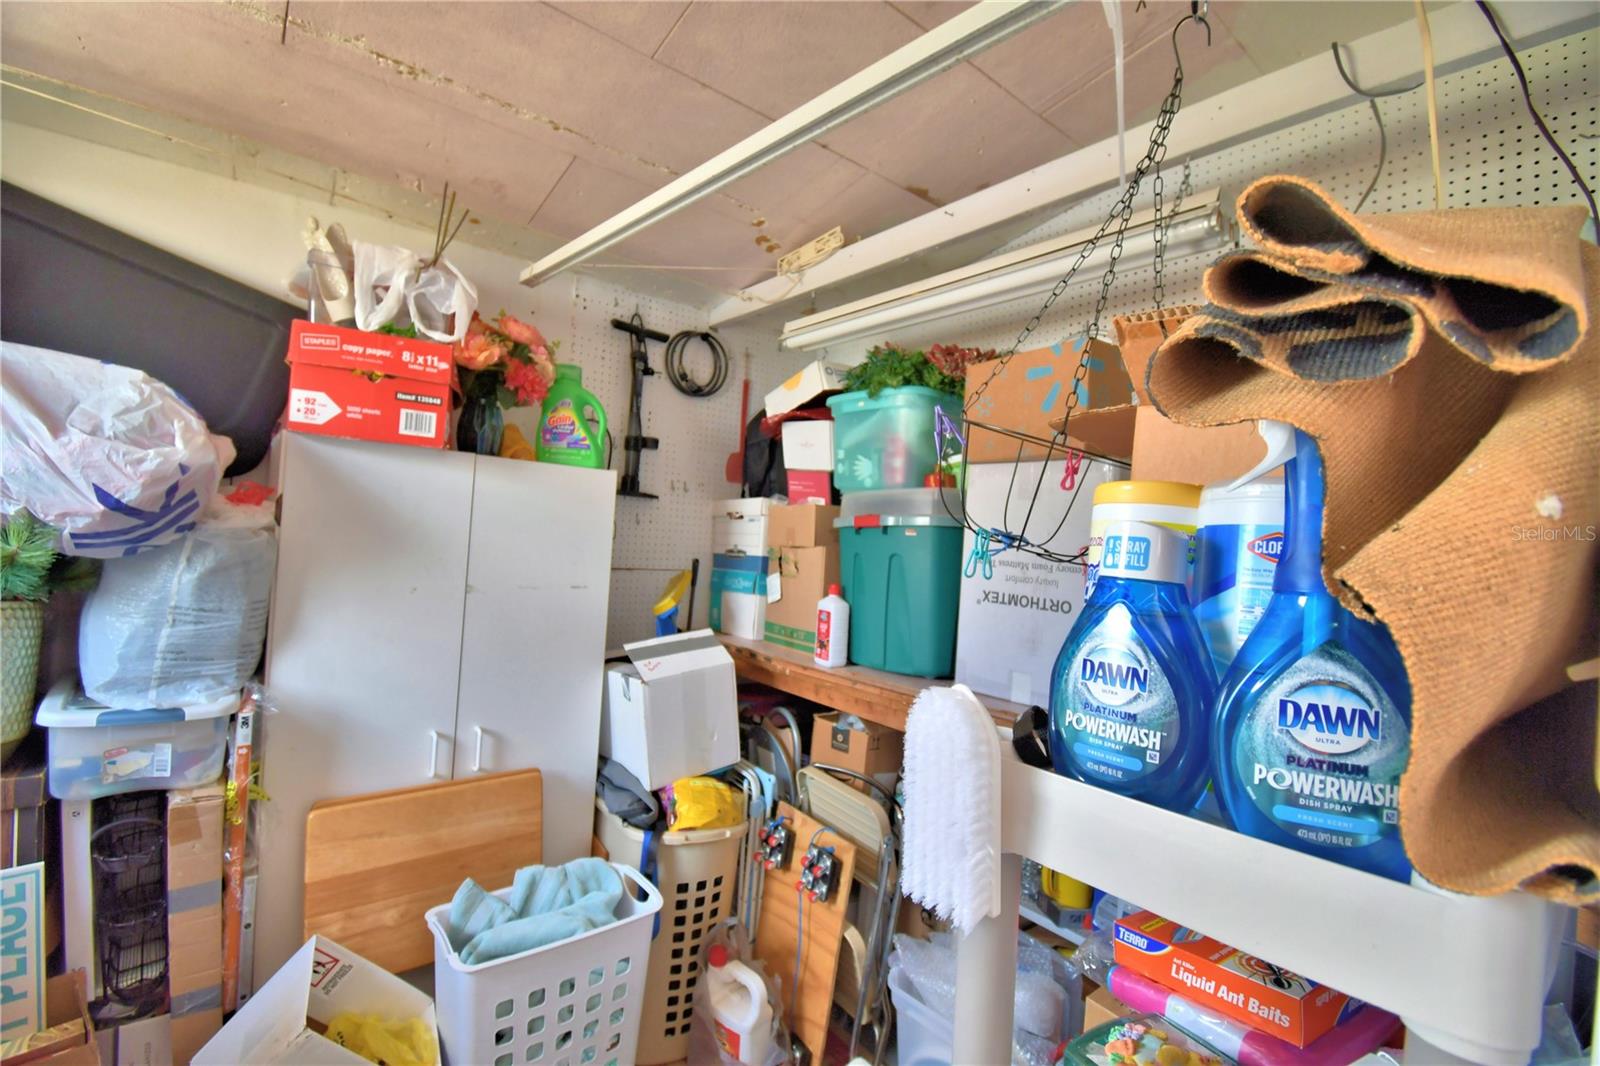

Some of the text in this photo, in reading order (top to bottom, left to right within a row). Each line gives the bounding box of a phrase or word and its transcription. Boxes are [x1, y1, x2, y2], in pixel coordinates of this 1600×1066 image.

[304, 337, 336, 347] STAPLES
[342, 344, 363, 354] copy
[417, 354, 425, 365] x
[304, 397, 317, 406] 92
[303, 407, 317, 416] 20
[1115, 540, 1147, 553] SRAY
[999, 559, 1029, 570] Mattress
[1114, 553, 1146, 567] RFILL
[1031, 562, 1053, 573] Foam
[1004, 574, 1059, 589] luxury comfort
[1081, 658, 1149, 693] DAWN
[1083, 702, 1137, 722] PLATINUM
[241, 715, 249, 729] 3M
[1278, 699, 1381, 741] DAWN
[1065, 709, 1161, 750] POWERWASH
[1104, 740, 1124, 751] SPRAY
[1315, 737, 1341, 745] ULTRA
[1286, 755, 1369, 777] PLATINUM
[1254, 763, 1399, 807] POWERWASH
[1299, 798, 1352, 813] DISH SPRAY
[1119, 927, 1148, 950] TERRO
[1170, 963, 1215, 994] Liquid
[1217, 984, 1245, 1007] Ant
[1248, 997, 1291, 1028] Baits
